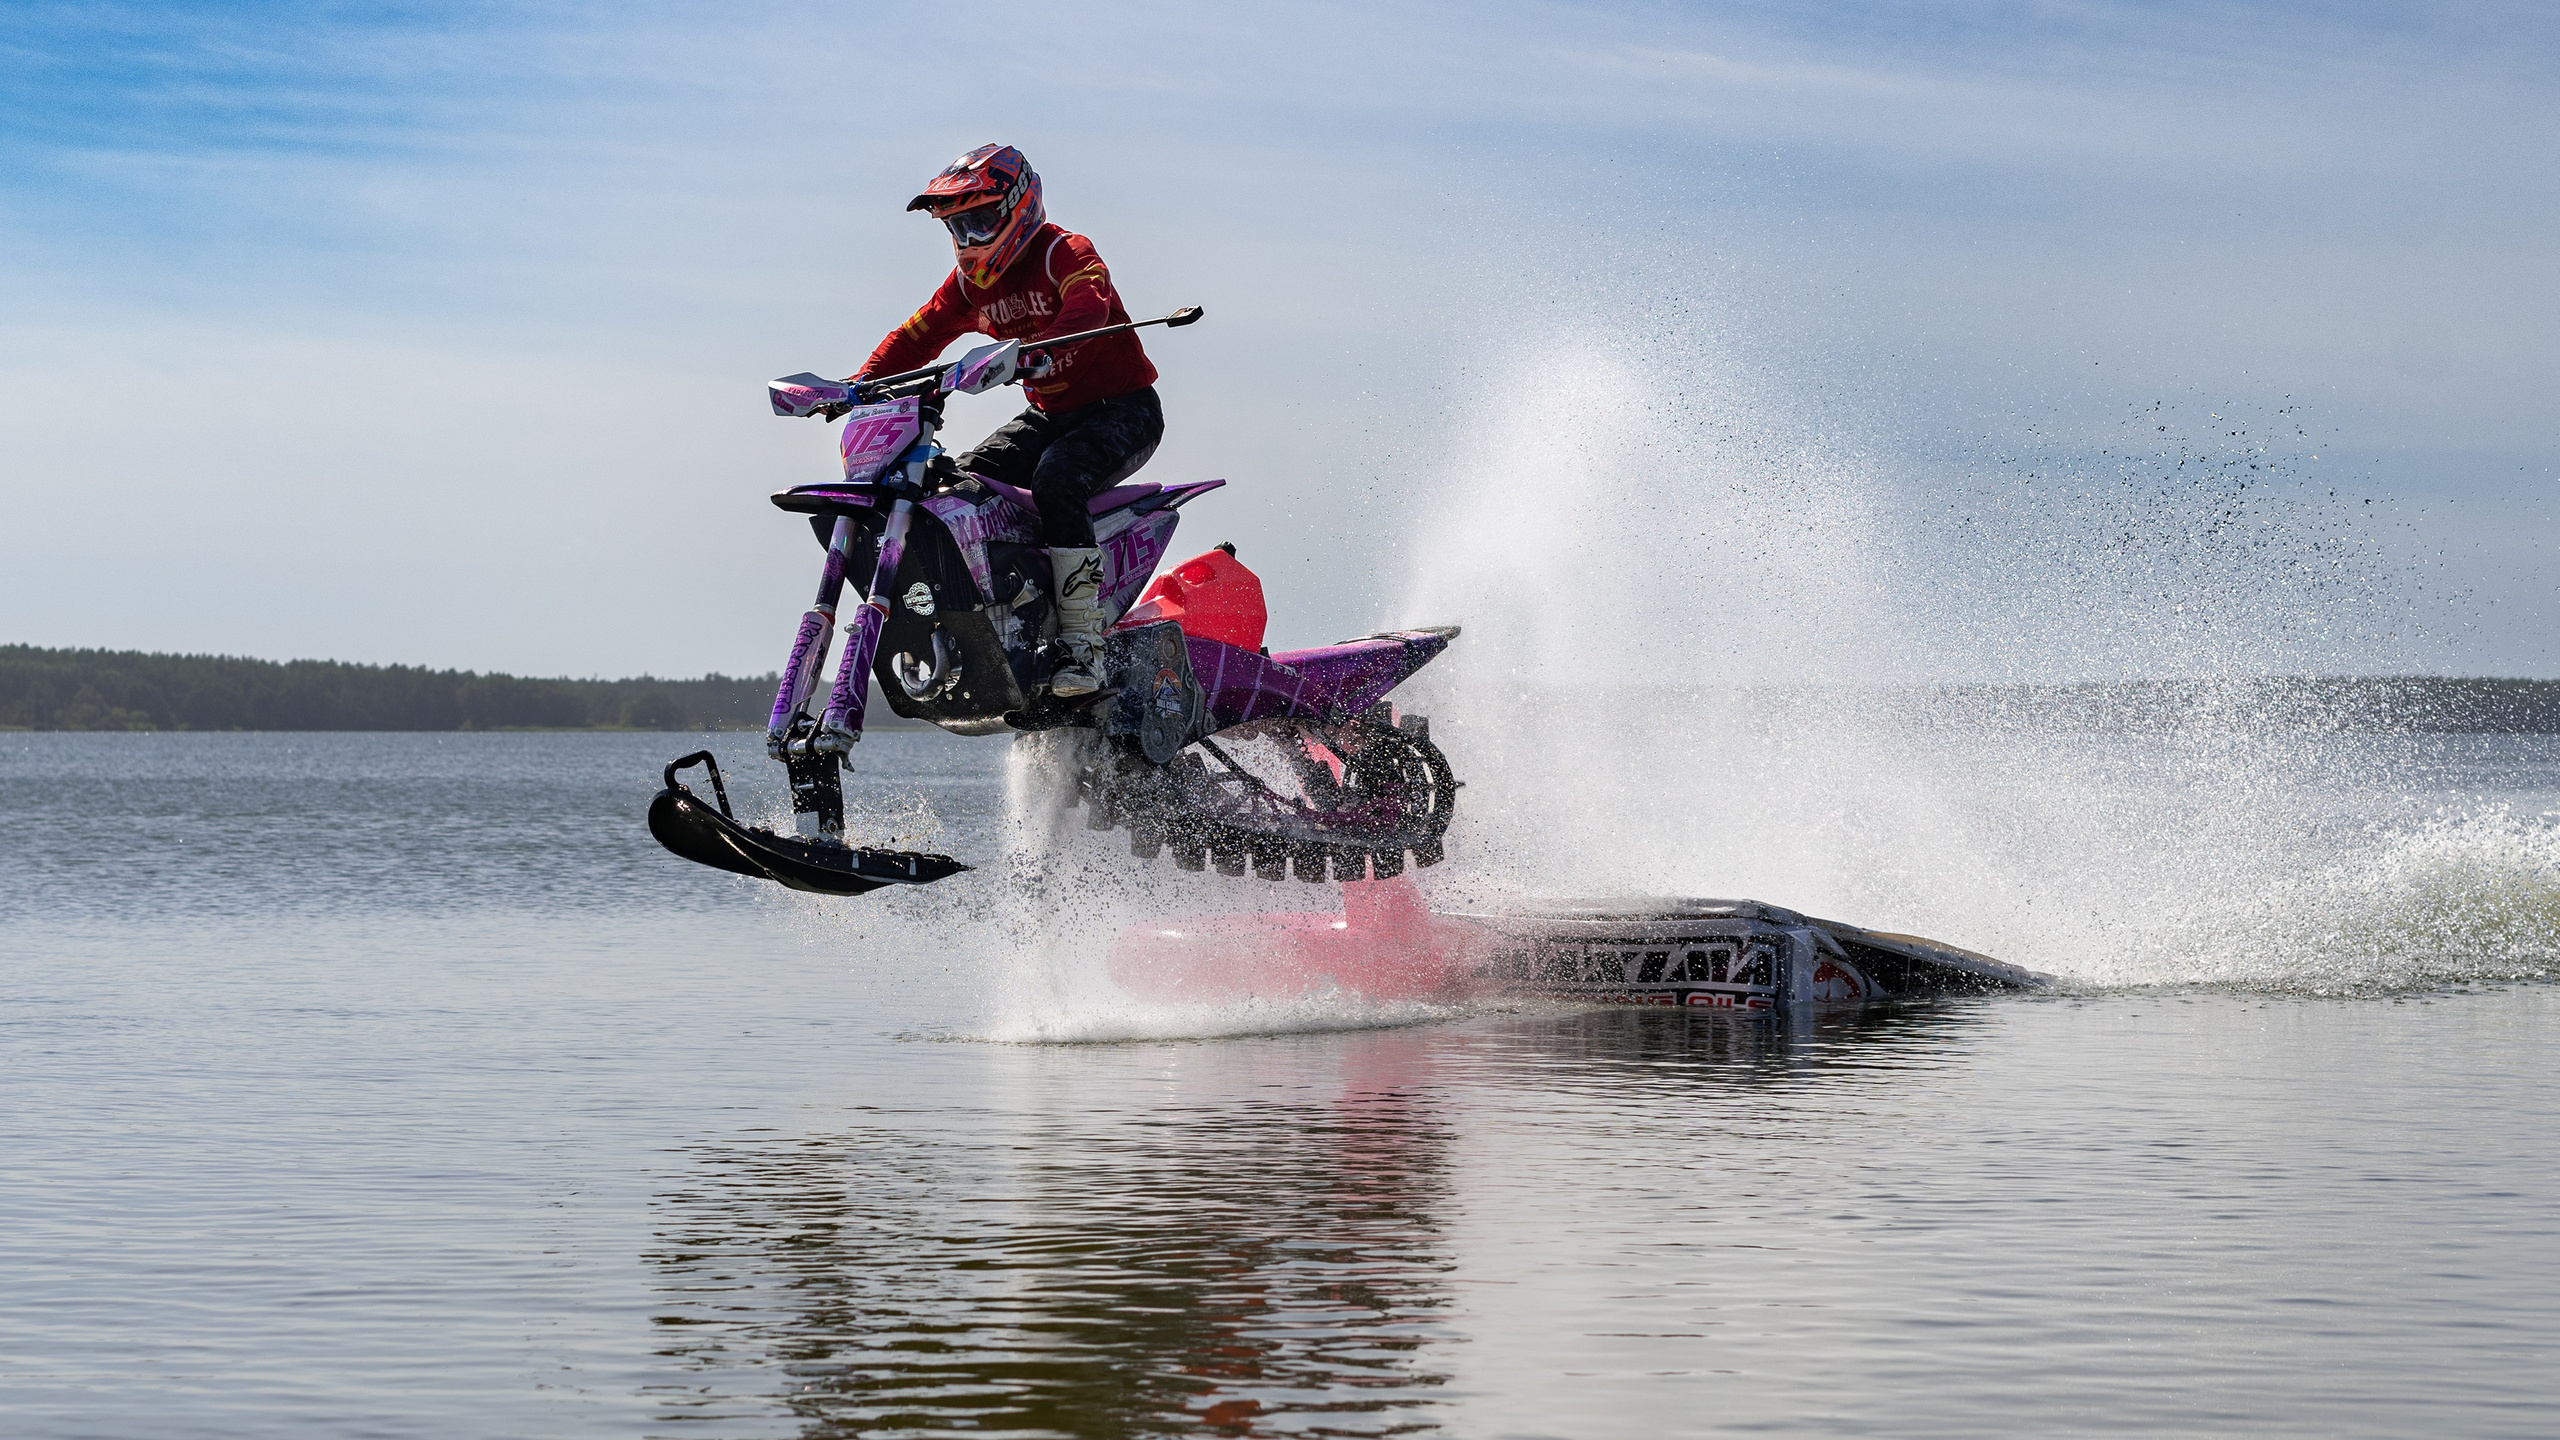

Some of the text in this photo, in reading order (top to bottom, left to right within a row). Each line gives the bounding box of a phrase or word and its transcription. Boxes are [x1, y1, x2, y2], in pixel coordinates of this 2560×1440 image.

[843, 416, 916, 459] 115
[1108, 525, 1153, 579] 115
[771, 620, 823, 715] KARAFUTO
[825, 616, 868, 710] KARAFUO
